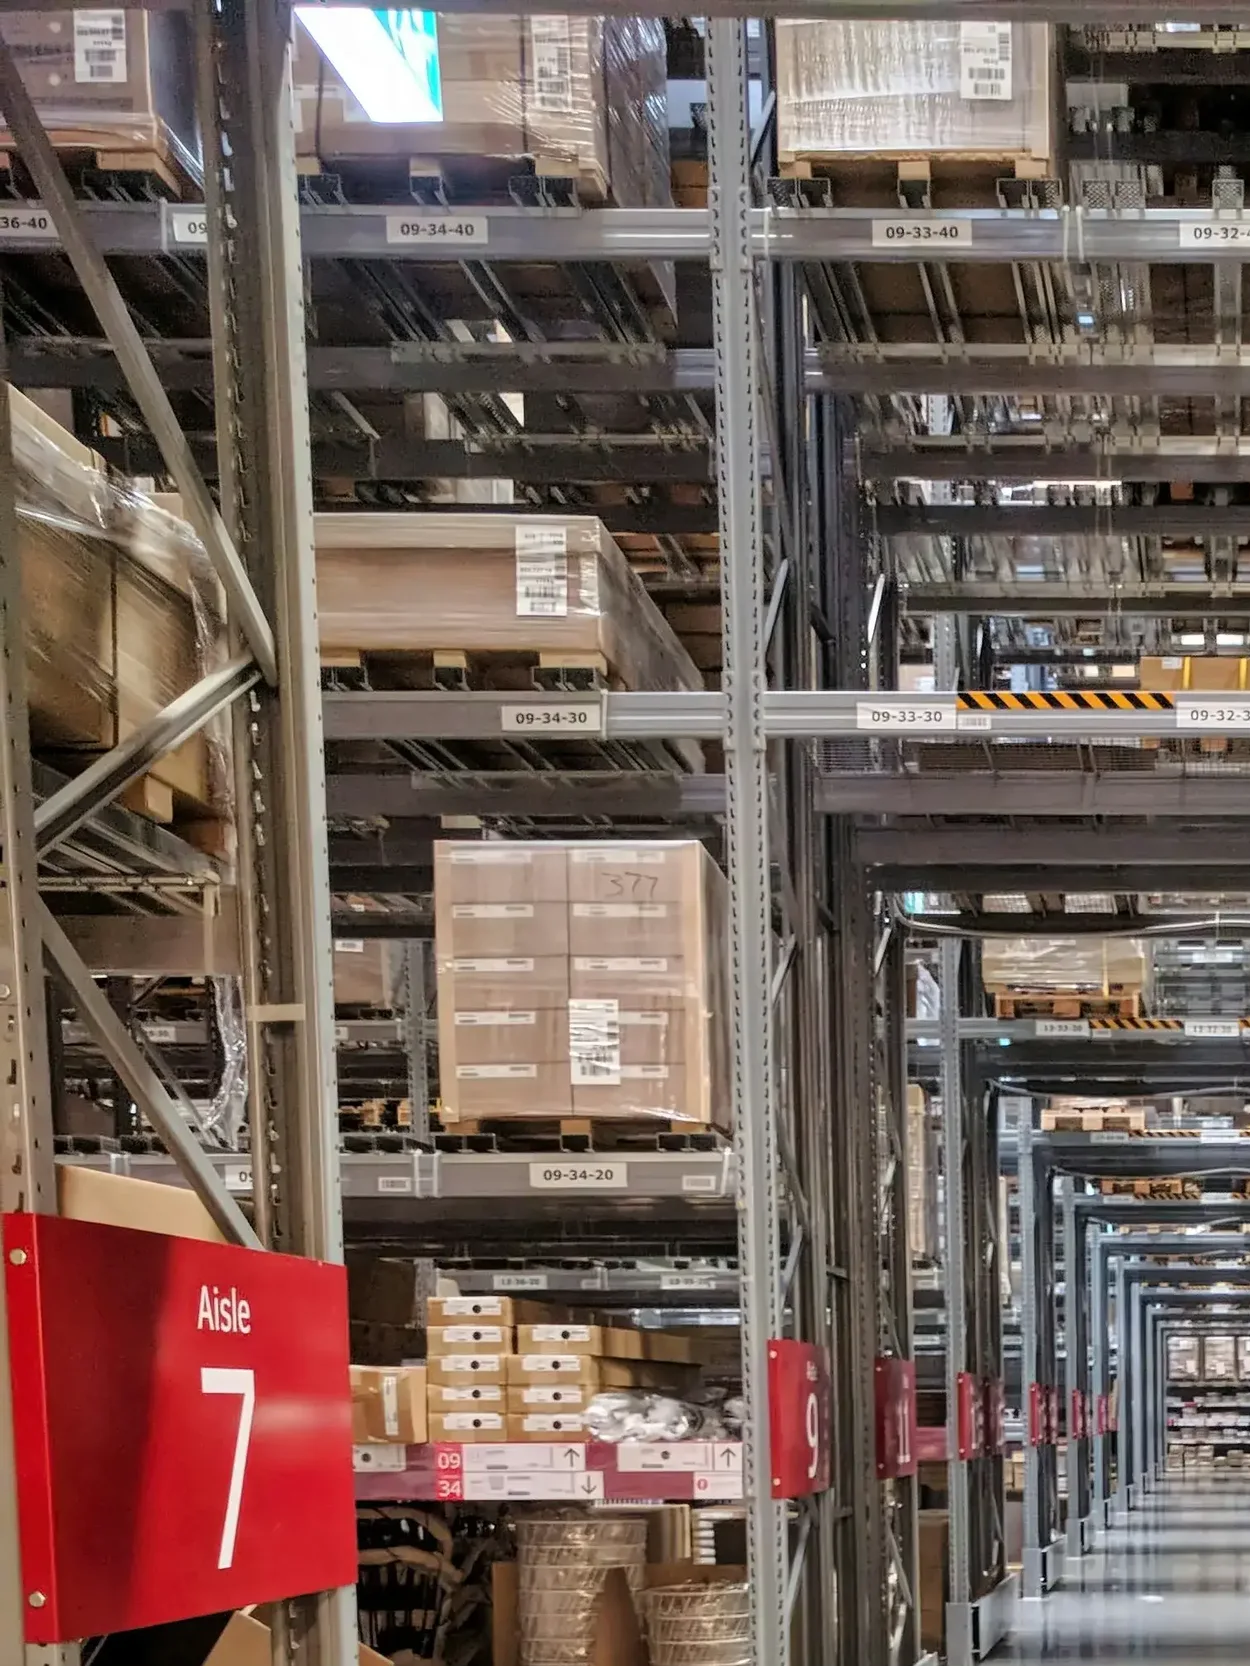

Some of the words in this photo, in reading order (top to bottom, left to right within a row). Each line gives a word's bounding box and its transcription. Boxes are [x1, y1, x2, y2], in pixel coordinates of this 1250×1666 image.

[400, 223, 474, 236] 09-34-40
[886, 226, 959, 239] 09-33-40
[516, 712, 587, 724] 09-34-30
[872, 711, 942, 722] 09-33-30
[601, 872, 658, 897] 377
[543, 1169, 614, 1181] 09-34-20
[197, 1284, 252, 1334] Aisle
[806, 1393, 818, 1478] 9
[200, 1367, 256, 1570] 7
[437, 1452, 462, 1469] 09
[438, 1479, 463, 1497] 34
